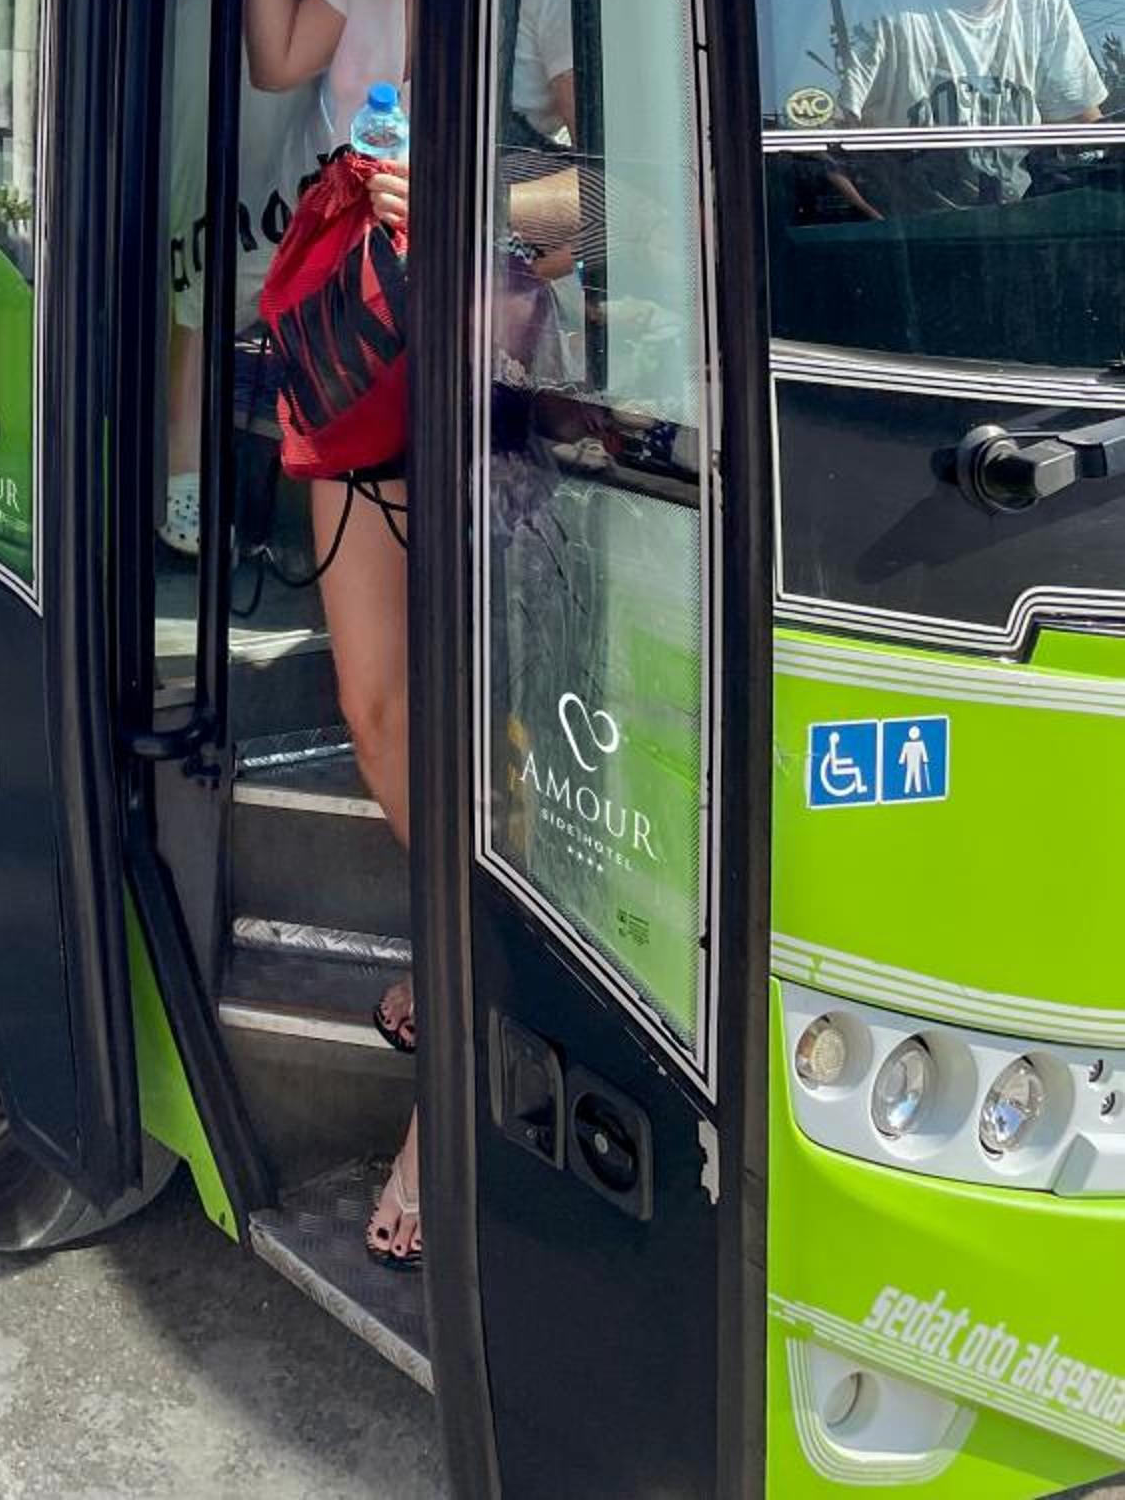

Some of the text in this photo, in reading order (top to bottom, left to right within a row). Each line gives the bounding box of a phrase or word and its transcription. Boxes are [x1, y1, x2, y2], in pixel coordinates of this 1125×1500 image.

[519, 750, 658, 860] AMOUR
[864, 1285, 971, 1364] sedat
[956, 1321, 1020, 1381] oto
